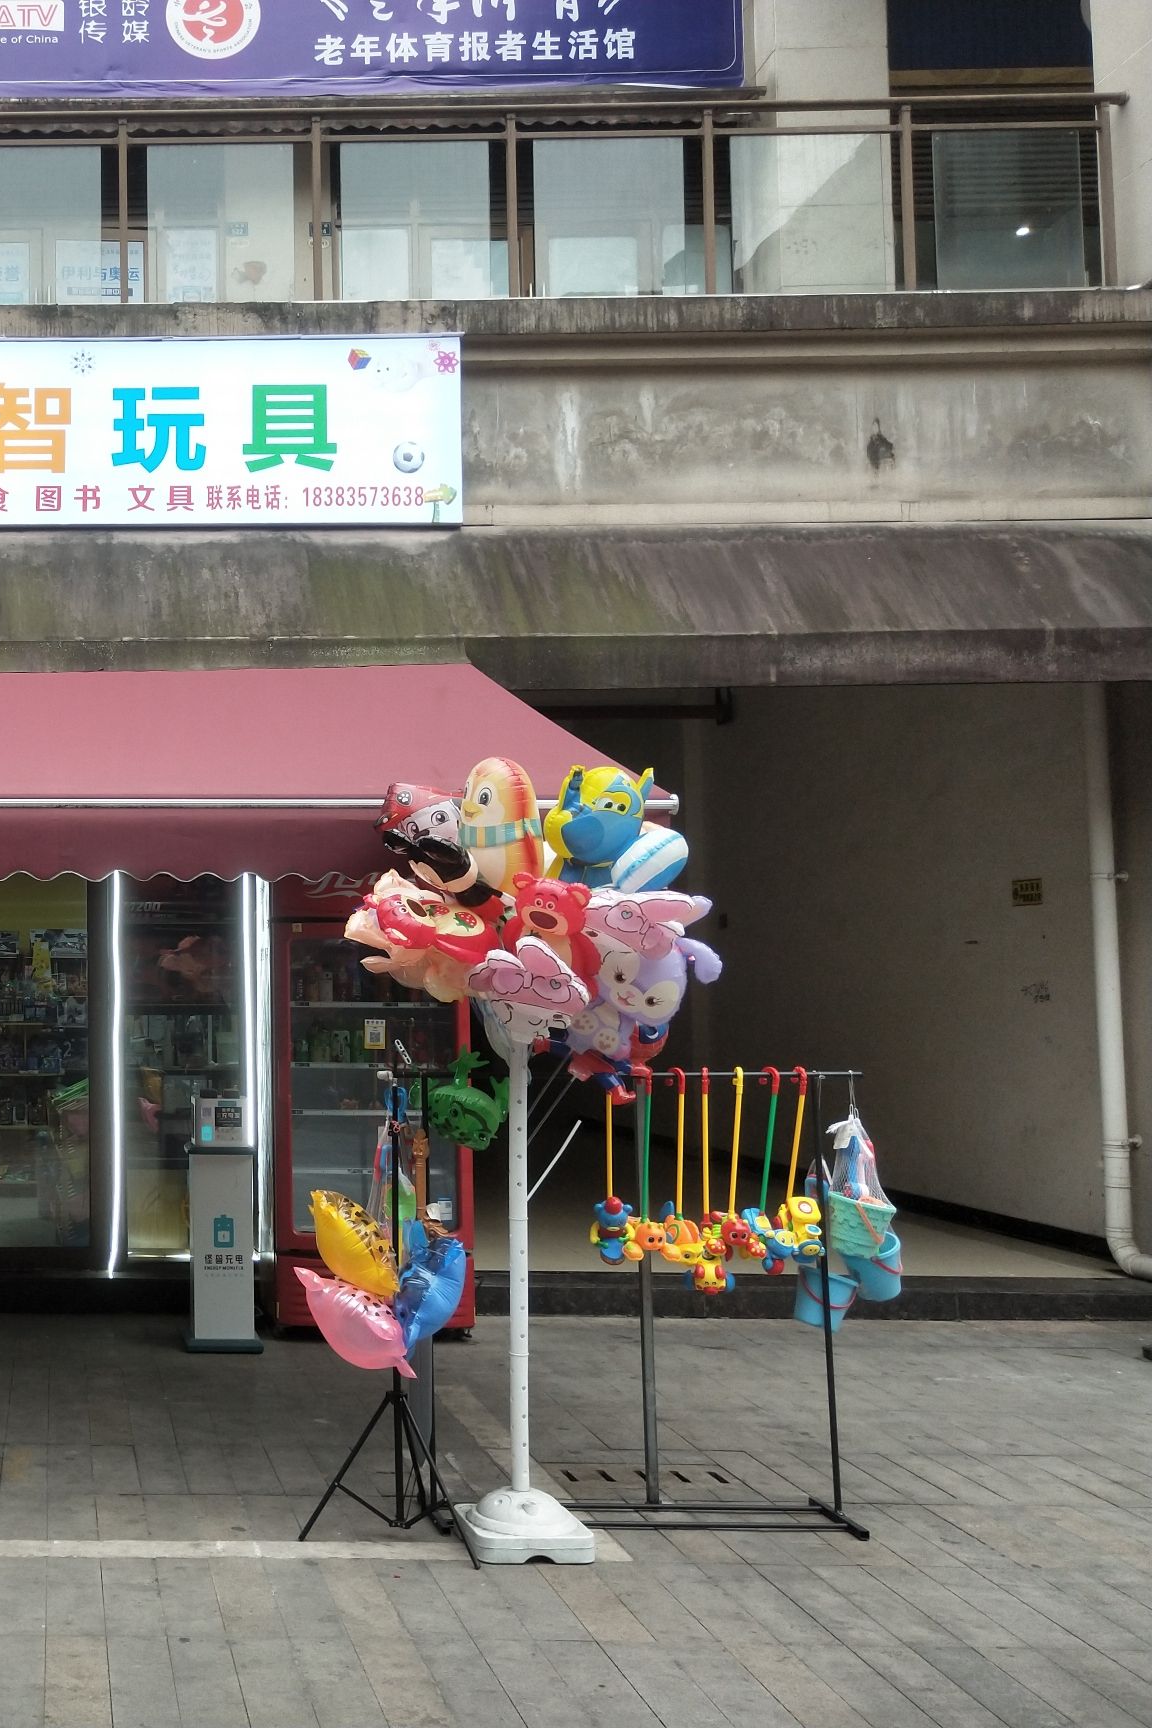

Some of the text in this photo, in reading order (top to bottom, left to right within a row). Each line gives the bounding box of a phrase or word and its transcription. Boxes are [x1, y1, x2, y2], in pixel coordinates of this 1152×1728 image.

[10, 35, 23, 44] of
[25, 35, 59, 44] China
[78, 20, 150, 44] 传媒
[314, 27, 636, 65] 老年体育报者生活馆
[61, 265, 140, 282] 伊利与奥运
[35, 485, 102, 513] 图书
[127, 485, 196, 513] 文具
[302, 485, 425, 508] 18383573638
[204, 1254, 244, 1264] 怪兽充电
